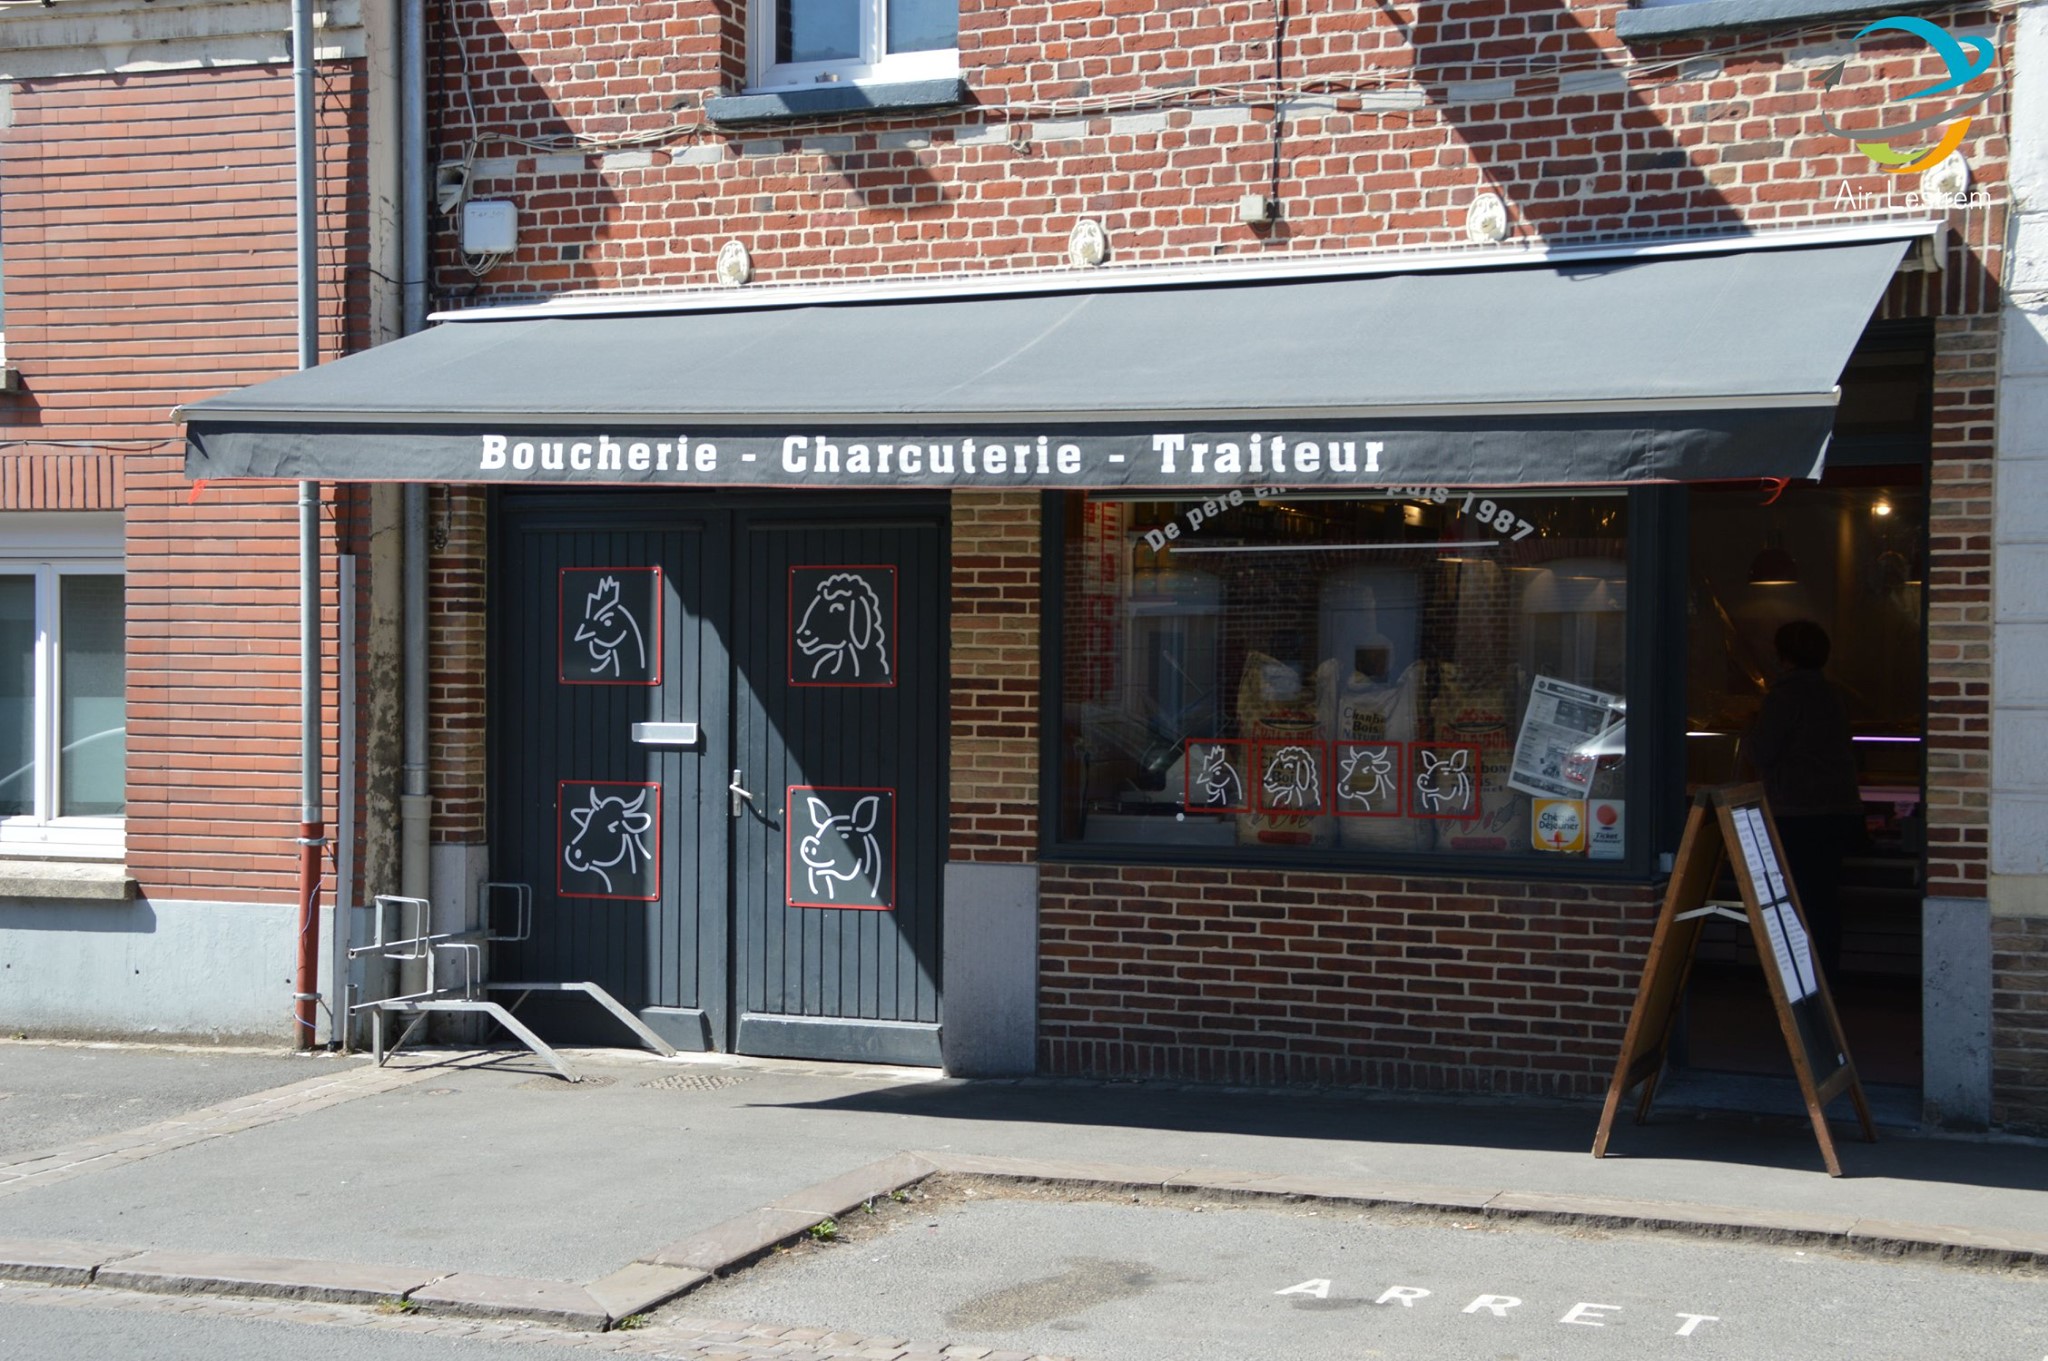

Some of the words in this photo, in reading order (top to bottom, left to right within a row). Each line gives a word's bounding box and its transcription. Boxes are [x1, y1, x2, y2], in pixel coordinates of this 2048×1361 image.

[480, 434, 717, 472] Boucherie
[782, 435, 1081, 474] Charcuterie
[1152, 433, 1385, 473] Traiteur
[1144, 522, 1181, 553] De
[1185, 487, 1244, 531] père
[1461, 491, 1535, 543] 1987
[1274, 1278, 1720, 1336] ARRET
